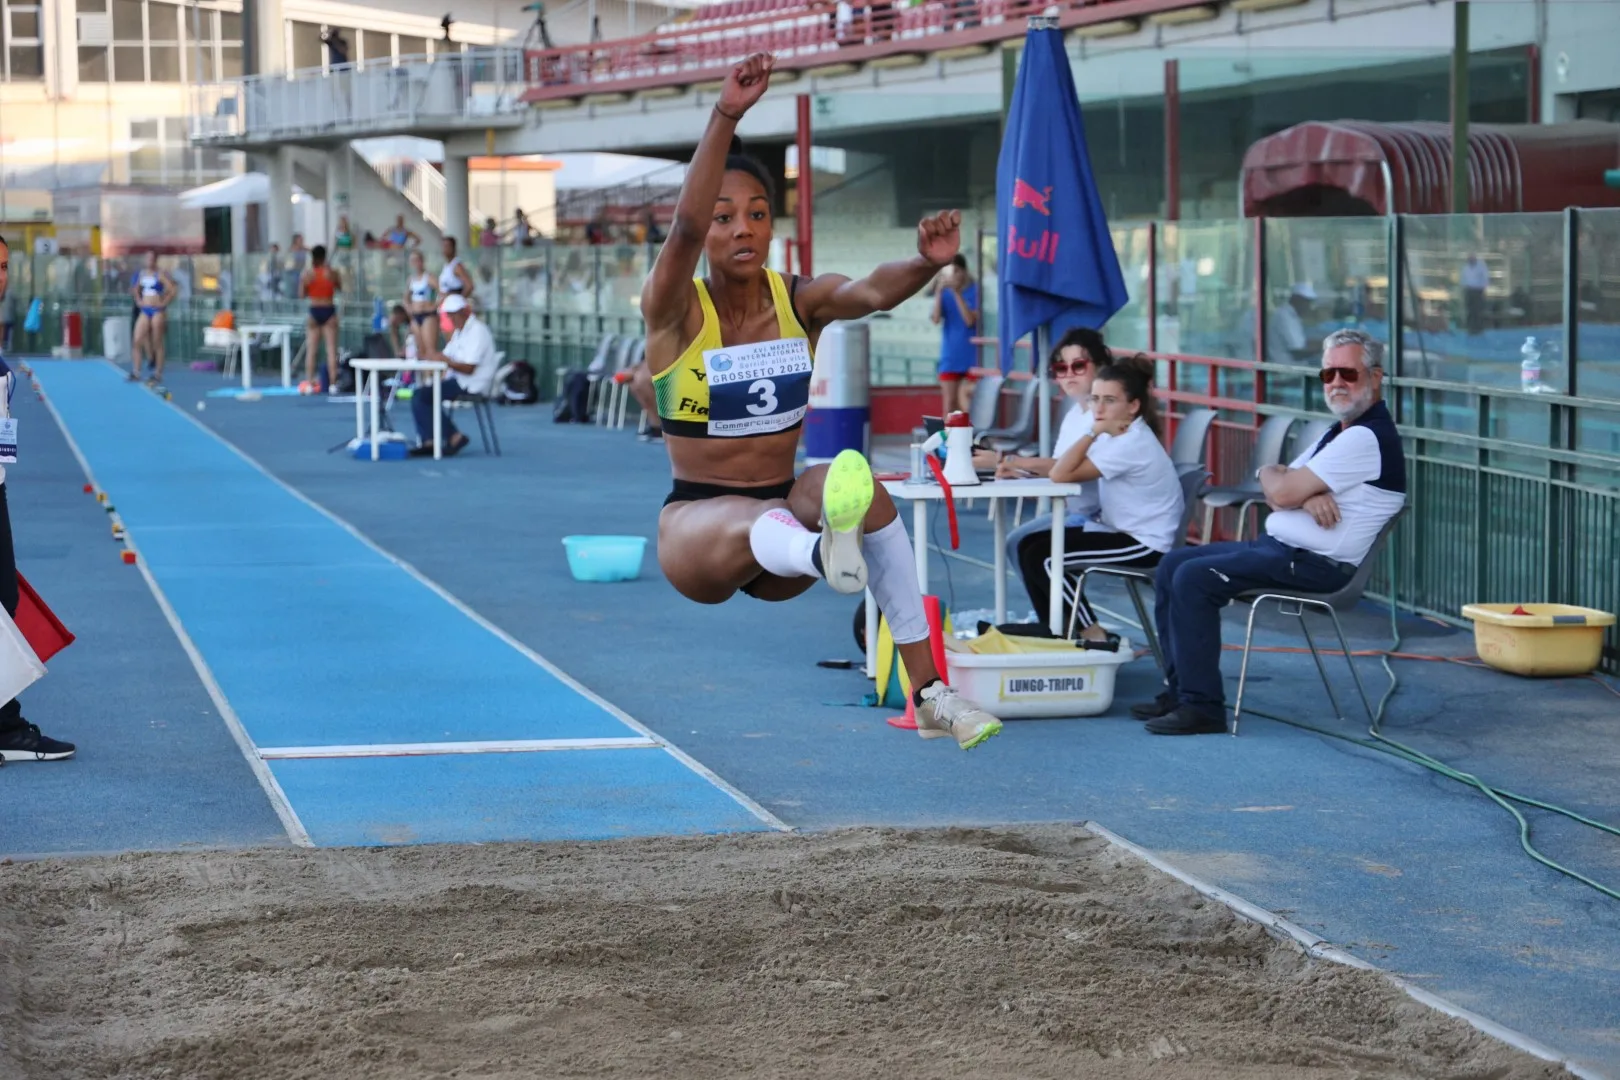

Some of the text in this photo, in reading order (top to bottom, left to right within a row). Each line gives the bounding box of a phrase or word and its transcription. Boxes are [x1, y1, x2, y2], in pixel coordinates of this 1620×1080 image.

[737, 347, 804, 361] INTERNAZIONALE
[770, 341, 804, 351] MEETING
[712, 362, 808, 383] GROSSETO 2022
[746, 379, 778, 416] 3
[1009, 677, 1084, 693] LUNGO-TRIPLO
